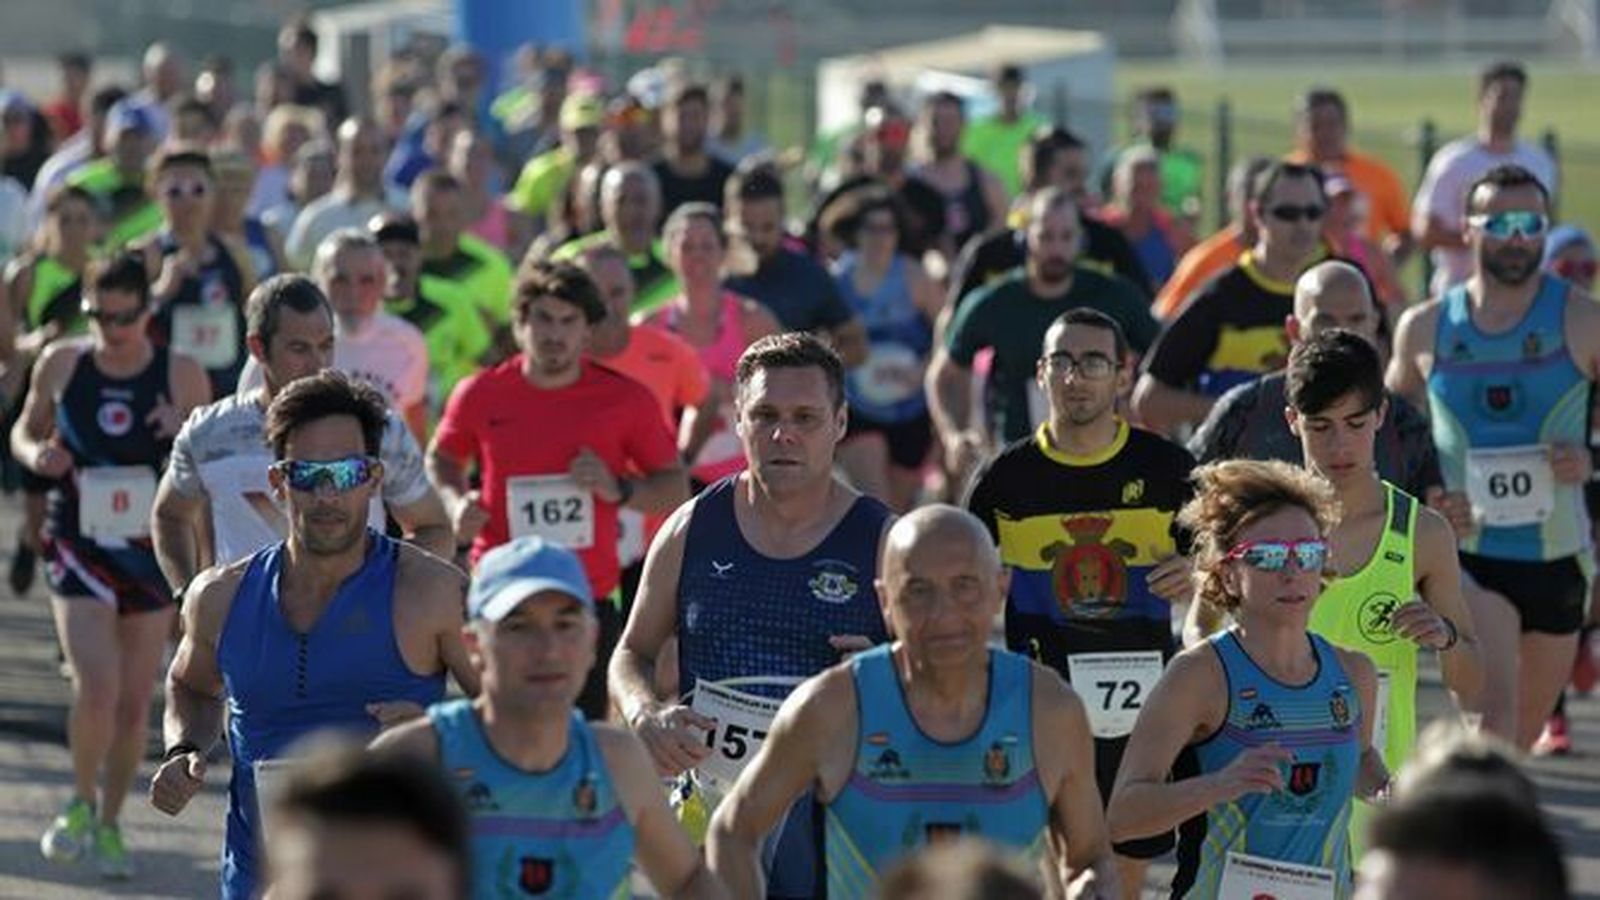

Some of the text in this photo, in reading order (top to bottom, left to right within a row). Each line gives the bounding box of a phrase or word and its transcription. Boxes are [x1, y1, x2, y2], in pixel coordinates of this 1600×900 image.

[1489, 470, 1532, 499] 60
[521, 497, 584, 526] 162
[1096, 680, 1141, 710] 72
